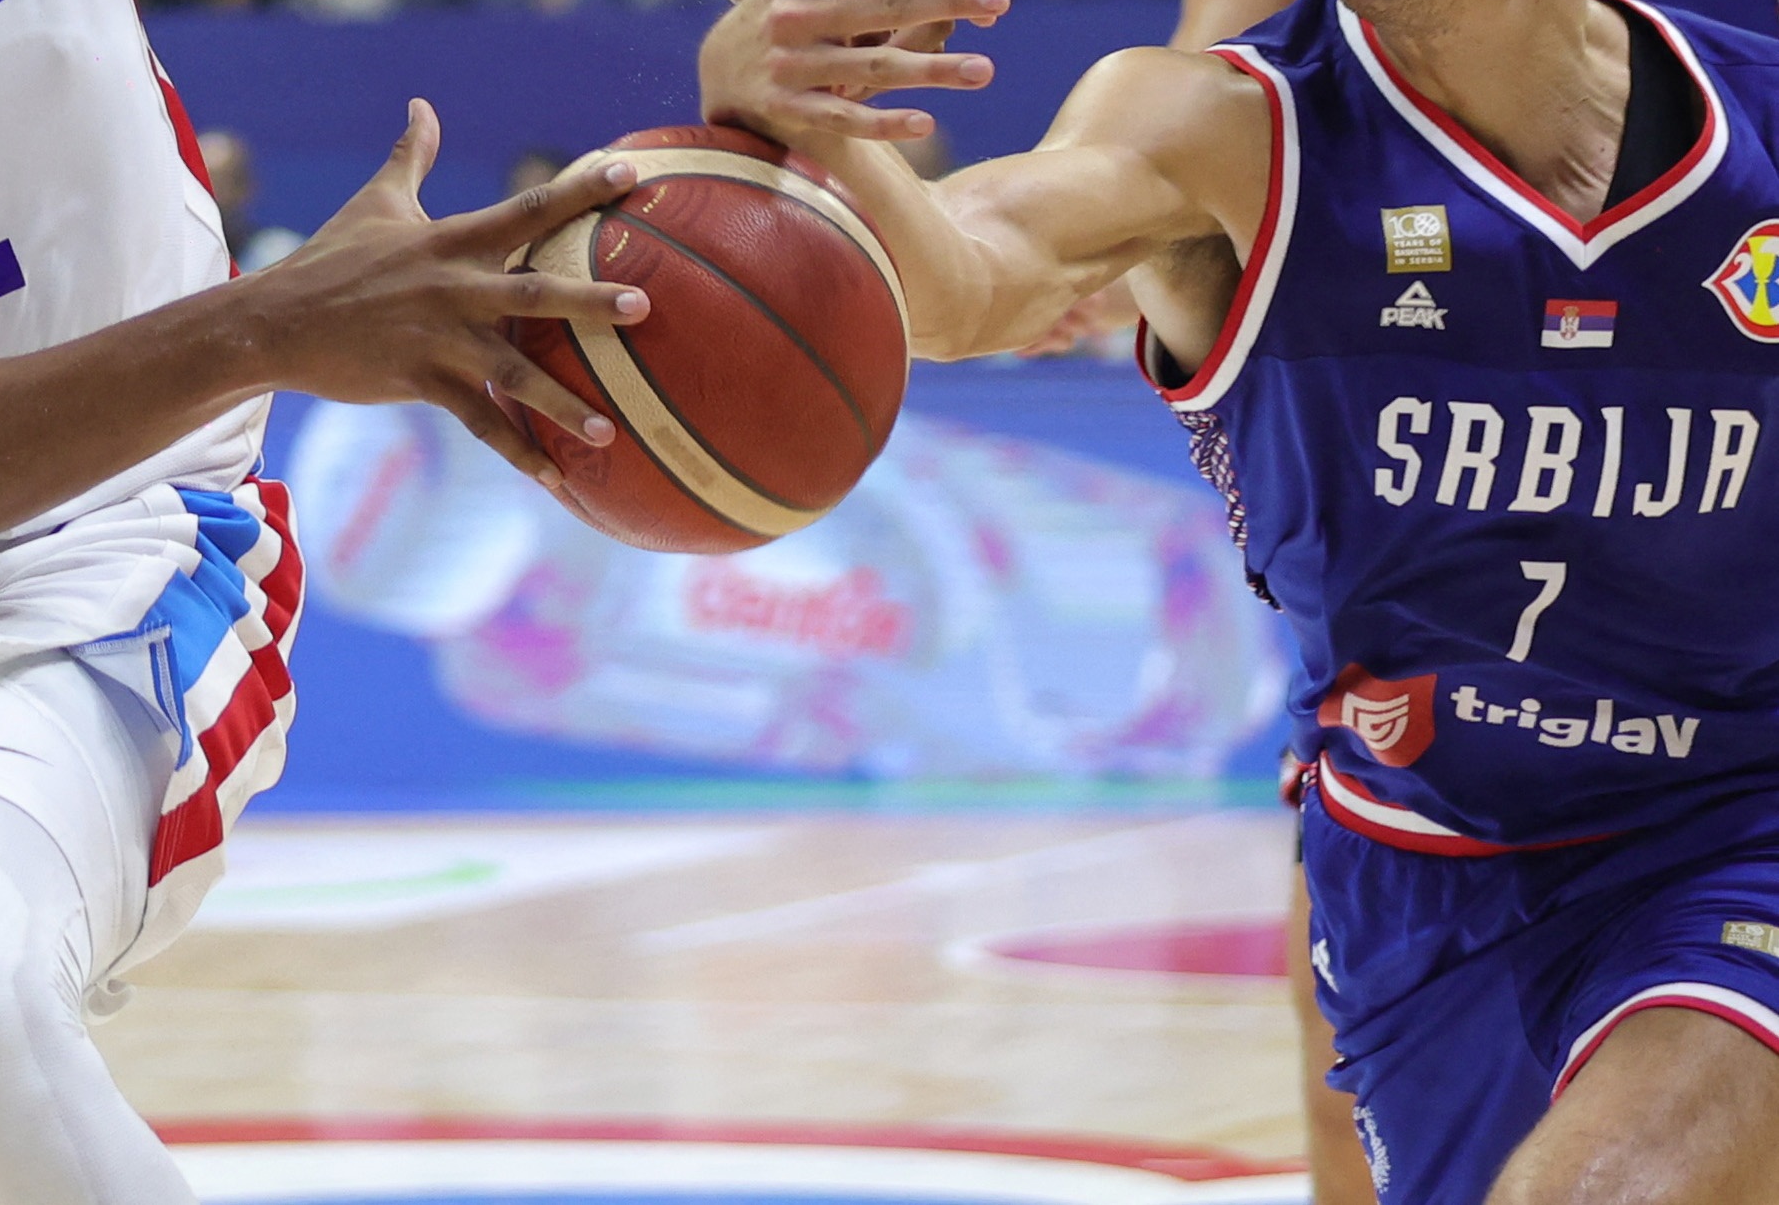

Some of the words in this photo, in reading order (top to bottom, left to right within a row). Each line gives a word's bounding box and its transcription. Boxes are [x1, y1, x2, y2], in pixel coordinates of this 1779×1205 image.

[1393, 239, 1425, 248] YEARS
[1429, 238, 1443, 247] OF
[1380, 307, 1449, 331] PEAK
[1374, 396, 1760, 519] SRBIJA
[1504, 561, 1567, 664] 7
[1450, 685, 1701, 758] triglav
